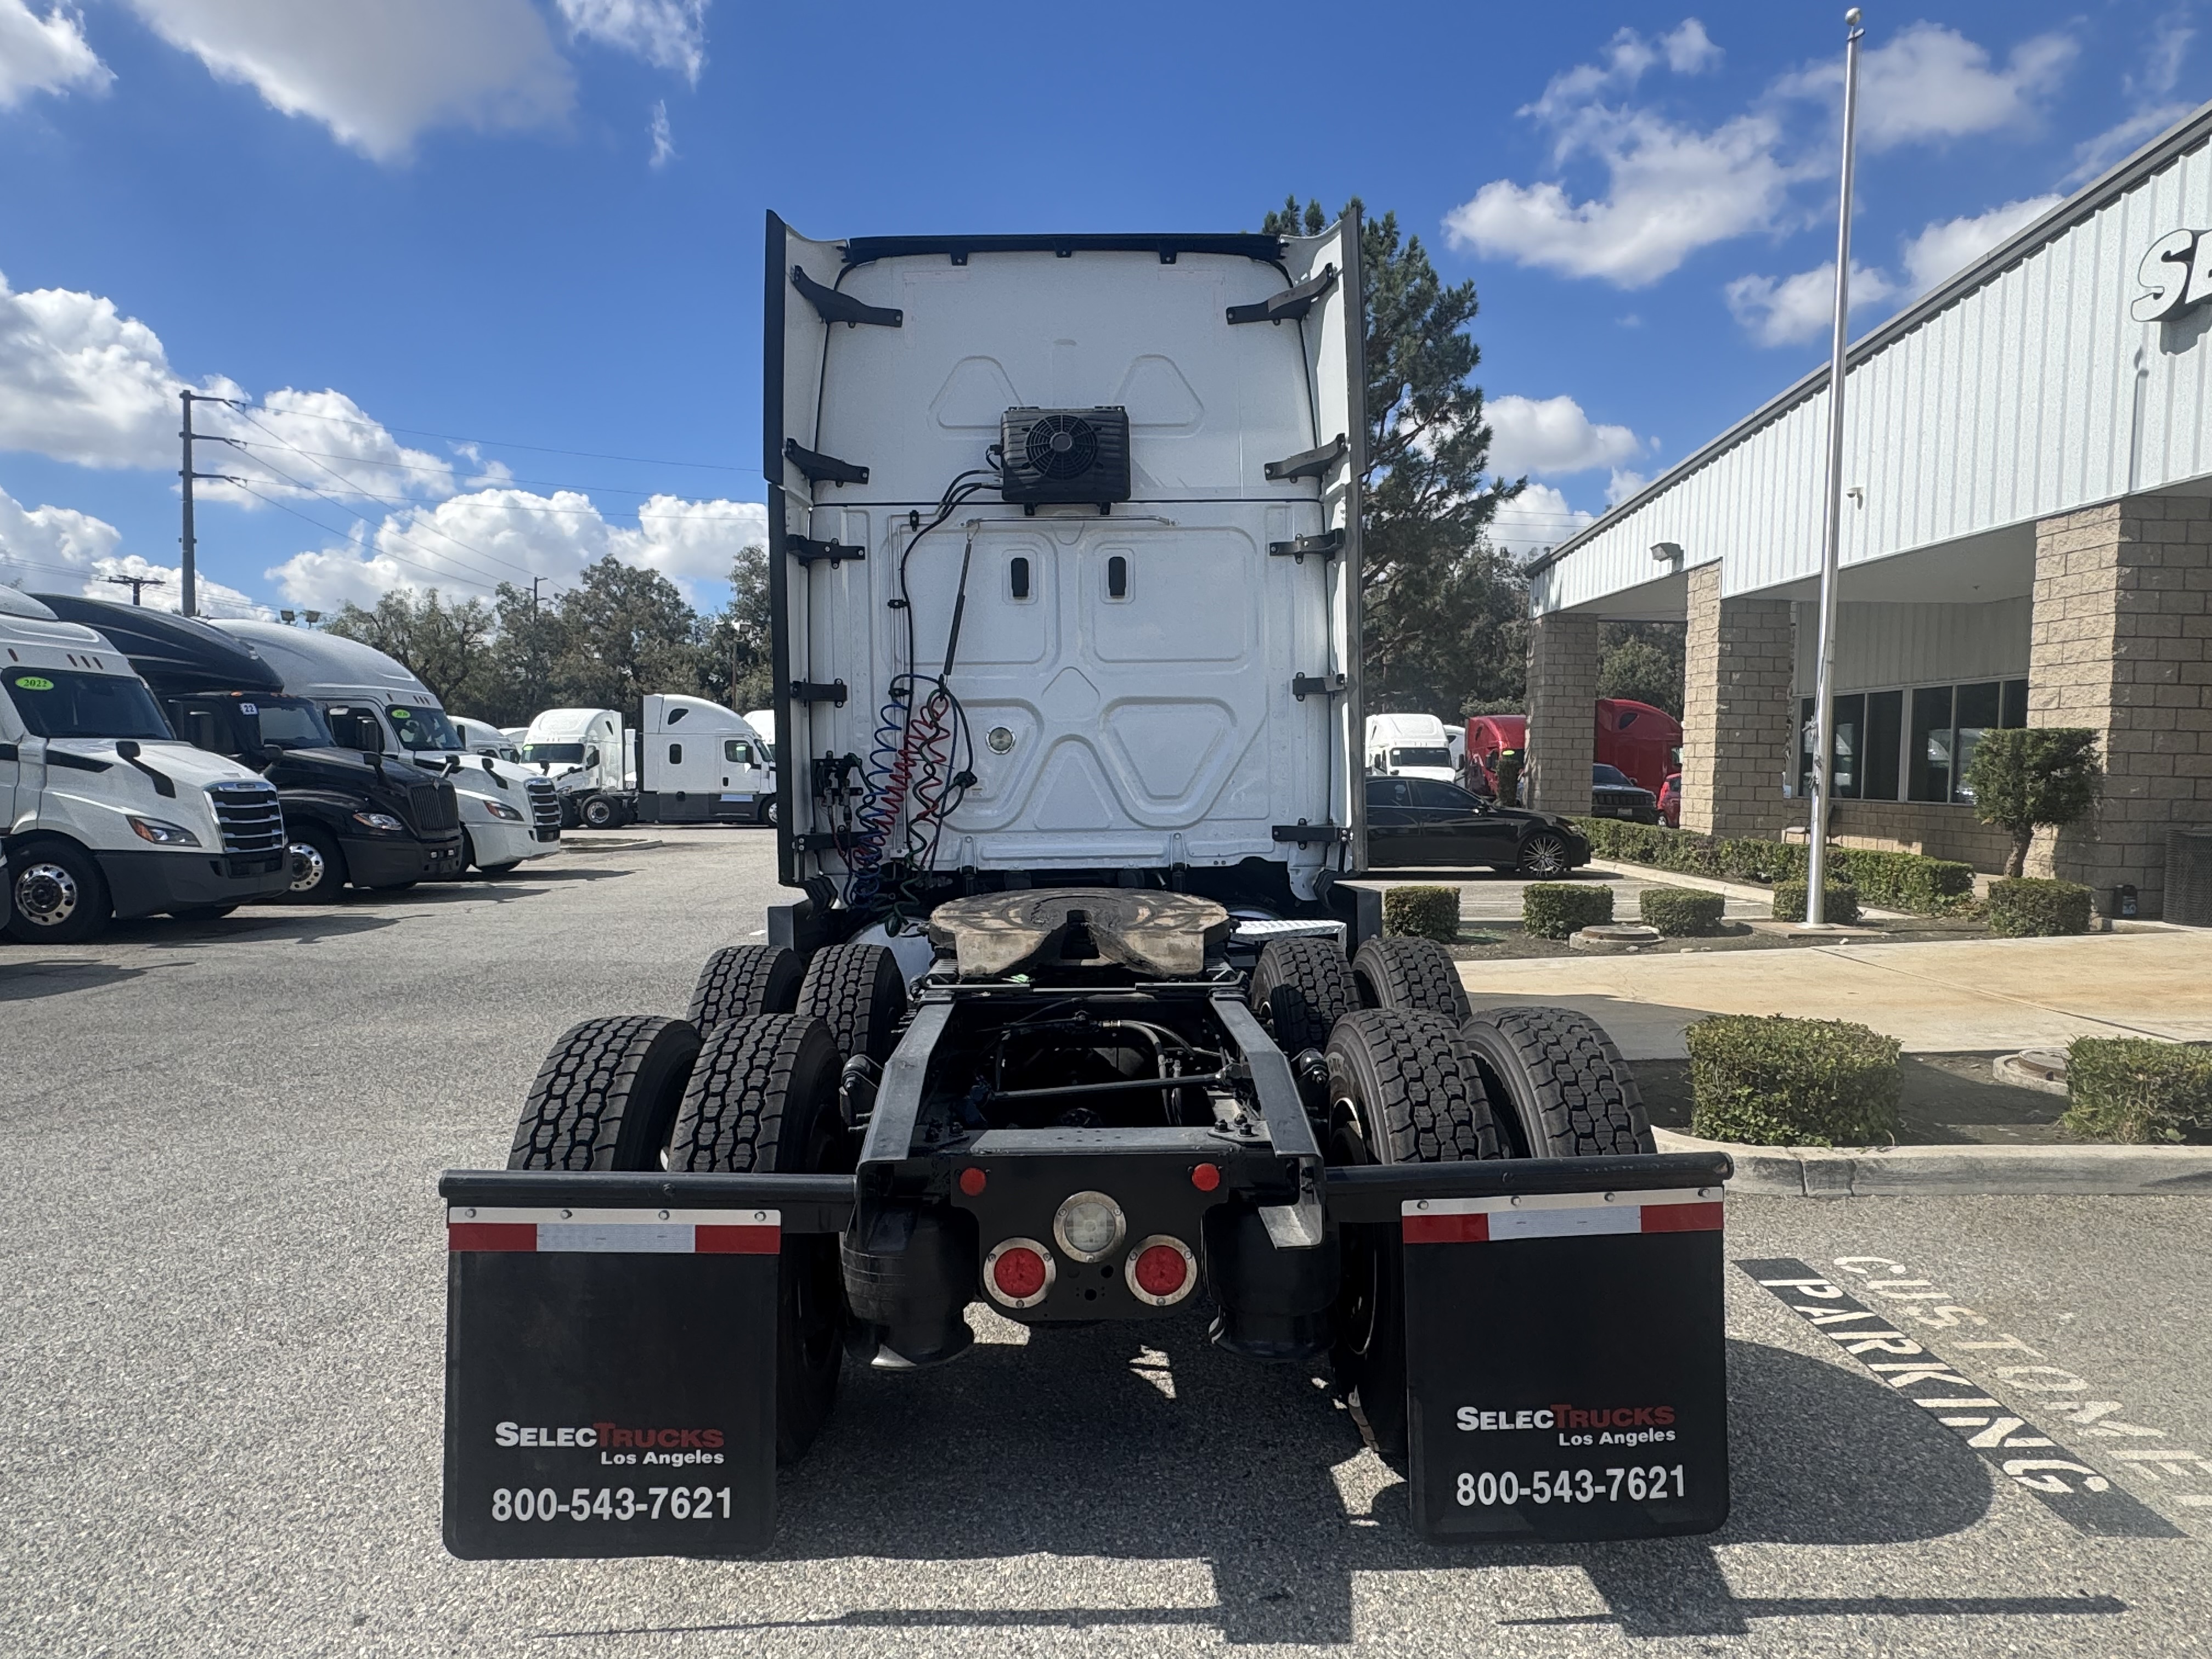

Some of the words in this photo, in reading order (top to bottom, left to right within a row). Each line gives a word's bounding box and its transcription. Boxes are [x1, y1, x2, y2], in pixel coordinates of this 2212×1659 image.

[1758, 1279, 2110, 1493] PARKING
[1833, 1256, 2212, 1507] CUSTOME
[1456, 1404, 1676, 1431] SELECTRUCKS
[495, 1421, 725, 1447] SELECTRUCKS
[1559, 1433, 1593, 1446] Los
[1599, 1427, 1676, 1447] Angeles
[601, 1451, 637, 1465] Los
[642, 1449, 725, 1467] Angeles
[1456, 1464, 1685, 1506] 800-543-7621
[492, 1486, 731, 1522] 800-543-7621
